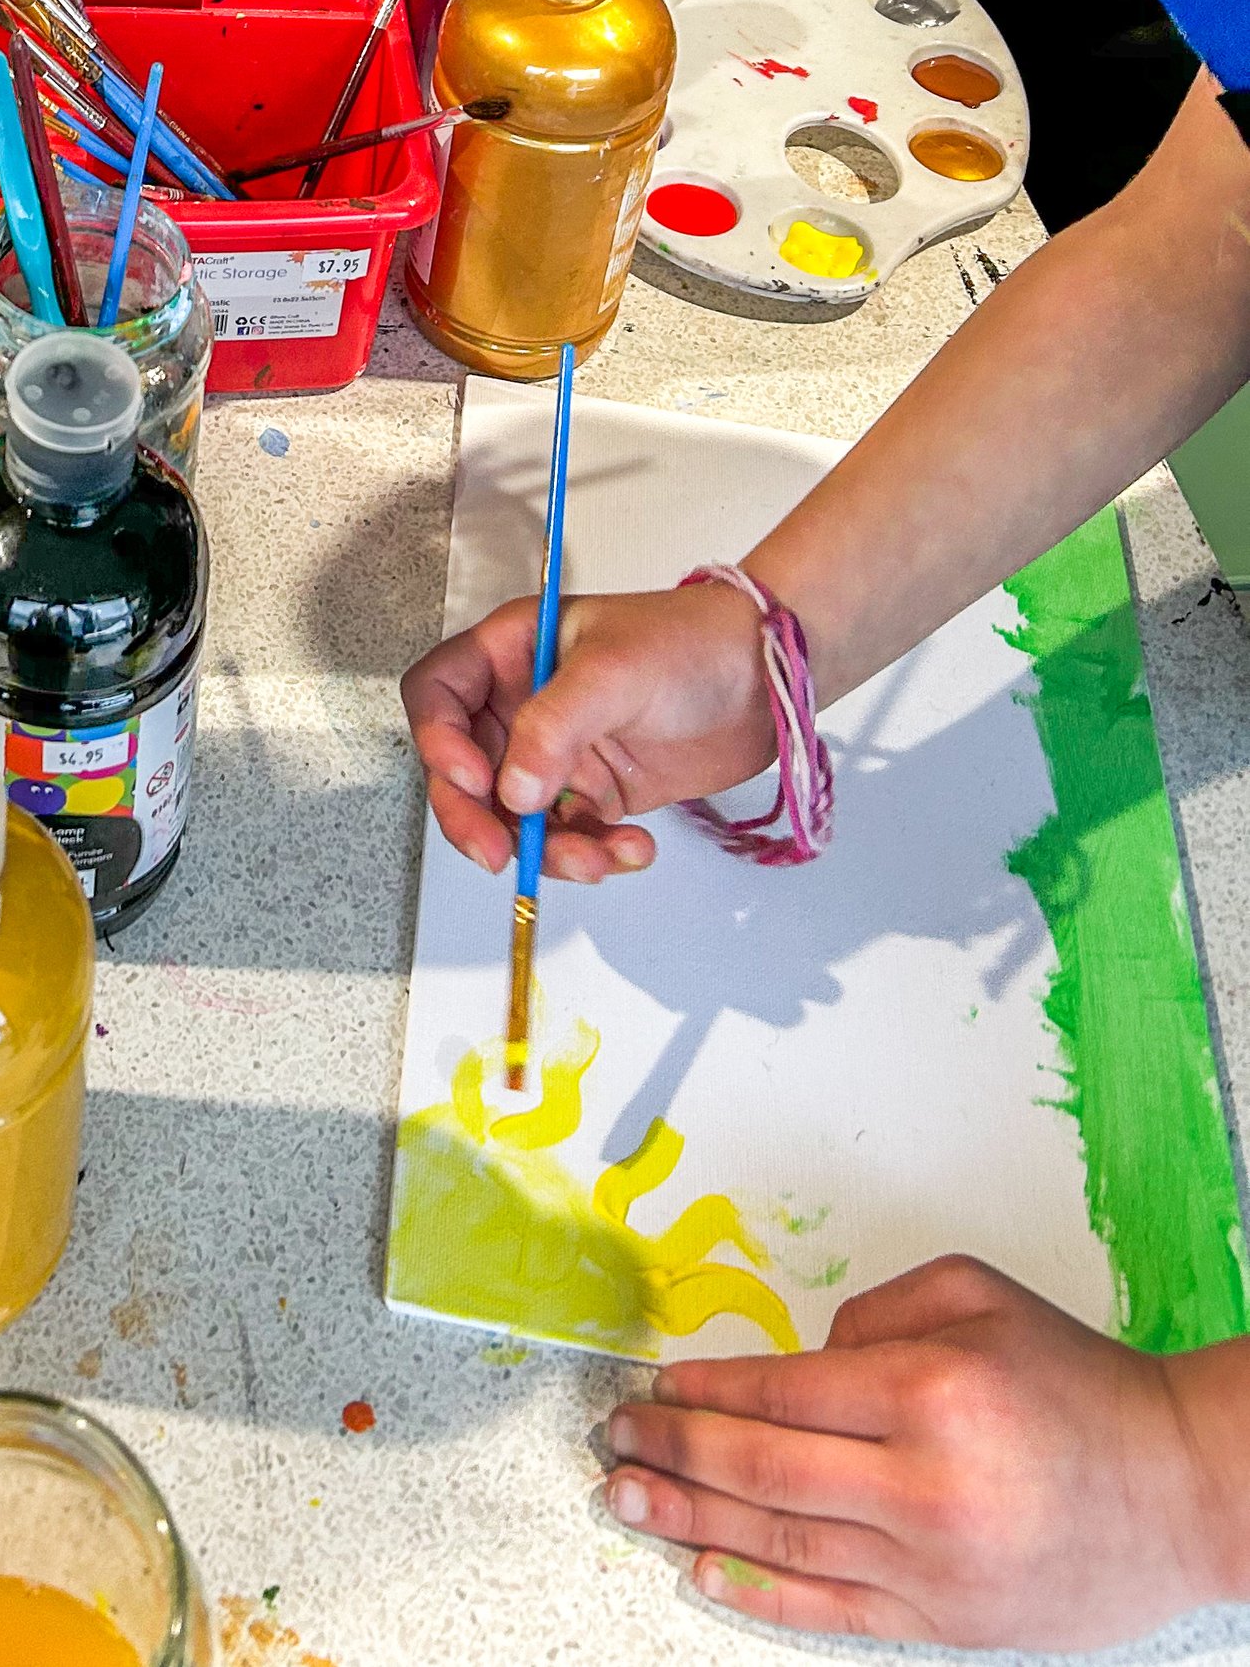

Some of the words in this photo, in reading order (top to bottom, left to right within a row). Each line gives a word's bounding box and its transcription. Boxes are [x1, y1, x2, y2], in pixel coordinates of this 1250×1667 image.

[169, 120, 191, 143] CHINA
[318, 258, 360, 273] $7.95
[222, 267, 288, 281] Storage
